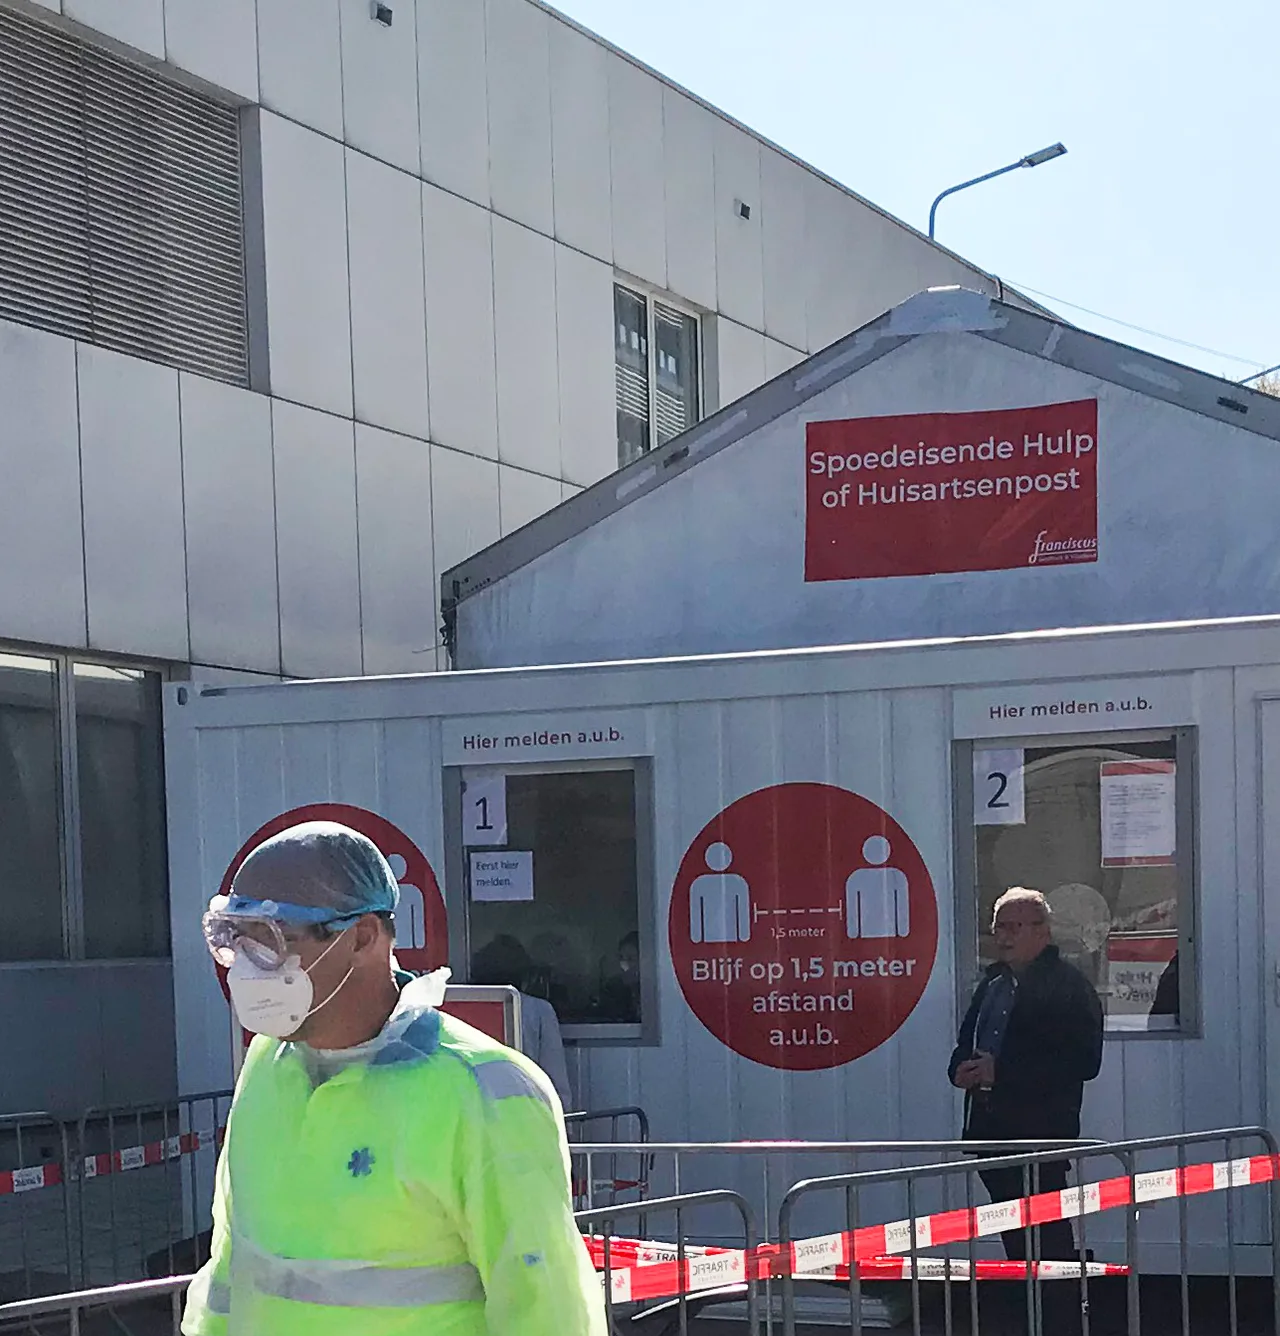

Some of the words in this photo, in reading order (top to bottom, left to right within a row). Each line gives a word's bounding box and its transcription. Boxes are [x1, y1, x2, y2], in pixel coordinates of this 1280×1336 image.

[810, 436, 1014, 478] Spoedeisende
[1023, 429, 1094, 459] Hulp
[821, 485, 849, 509] of
[858, 467, 1081, 505] Huisartsenpost
[1028, 530, 1097, 563] franciscus
[989, 704, 1025, 719] Hier
[1031, 700, 1099, 716] melden
[1105, 696, 1153, 712] a.u.b.
[463, 734, 499, 750] Hier
[504, 731, 571, 747] melden
[577, 727, 625, 743] a.u.b.
[986, 772, 1010, 809] 2
[475, 796, 494, 831] 1
[476, 861, 499, 871] Eerst
[788, 927, 826, 937] meter
[692, 958, 743, 985] Blijf
[749, 961, 784, 983] op
[790, 957, 824, 982] 1,5
[833, 956, 917, 978] meter
[752, 990, 853, 1013] afstand
[769, 1024, 839, 1047] a.u.b.
